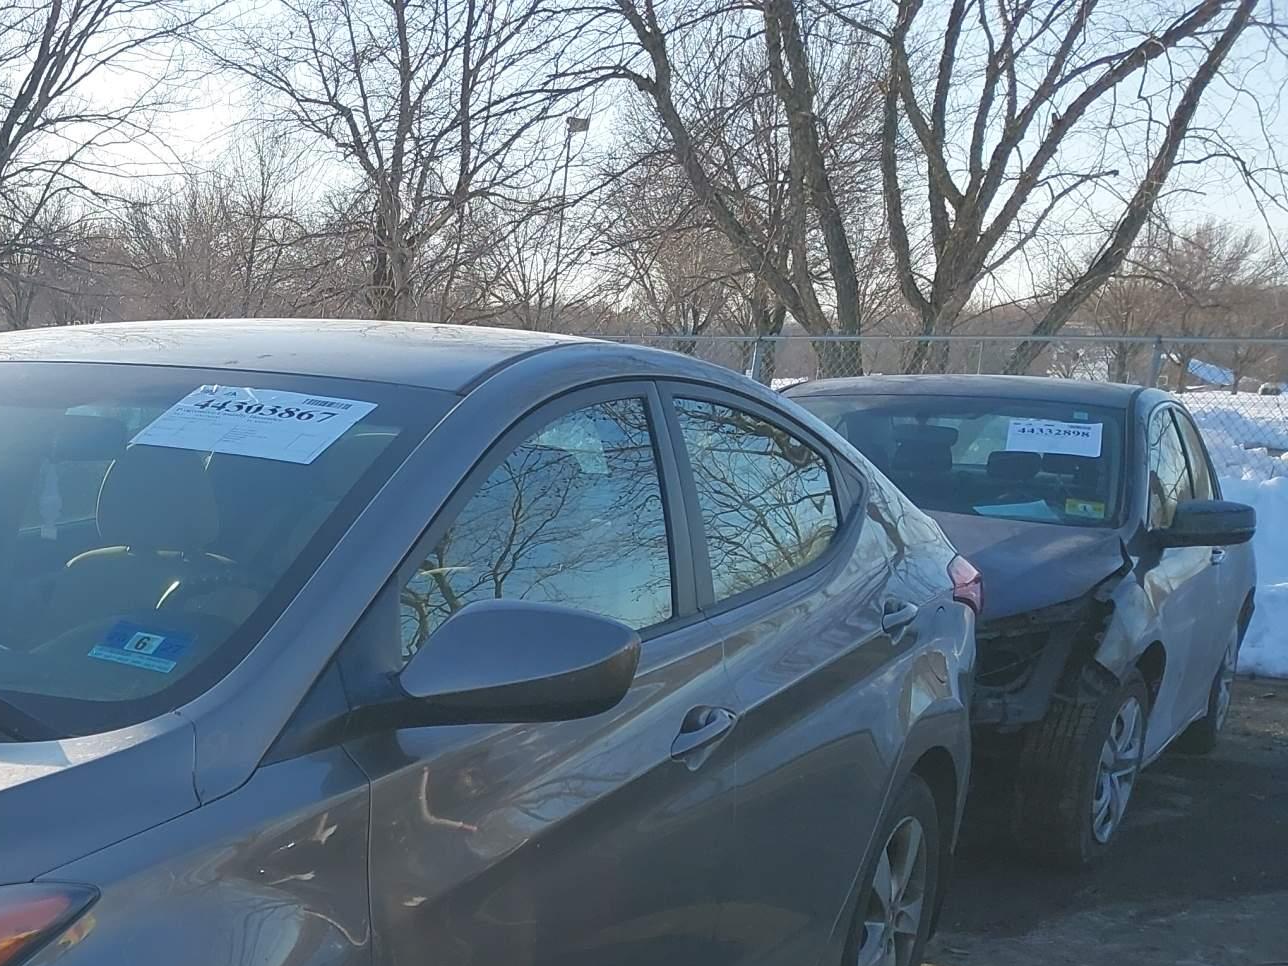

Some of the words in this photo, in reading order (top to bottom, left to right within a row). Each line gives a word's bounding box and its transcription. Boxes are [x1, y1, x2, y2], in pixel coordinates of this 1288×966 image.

[193, 398, 339, 423] 44303867
[1017, 427, 1091, 438] 44332898
[134, 636, 151, 651] 6
